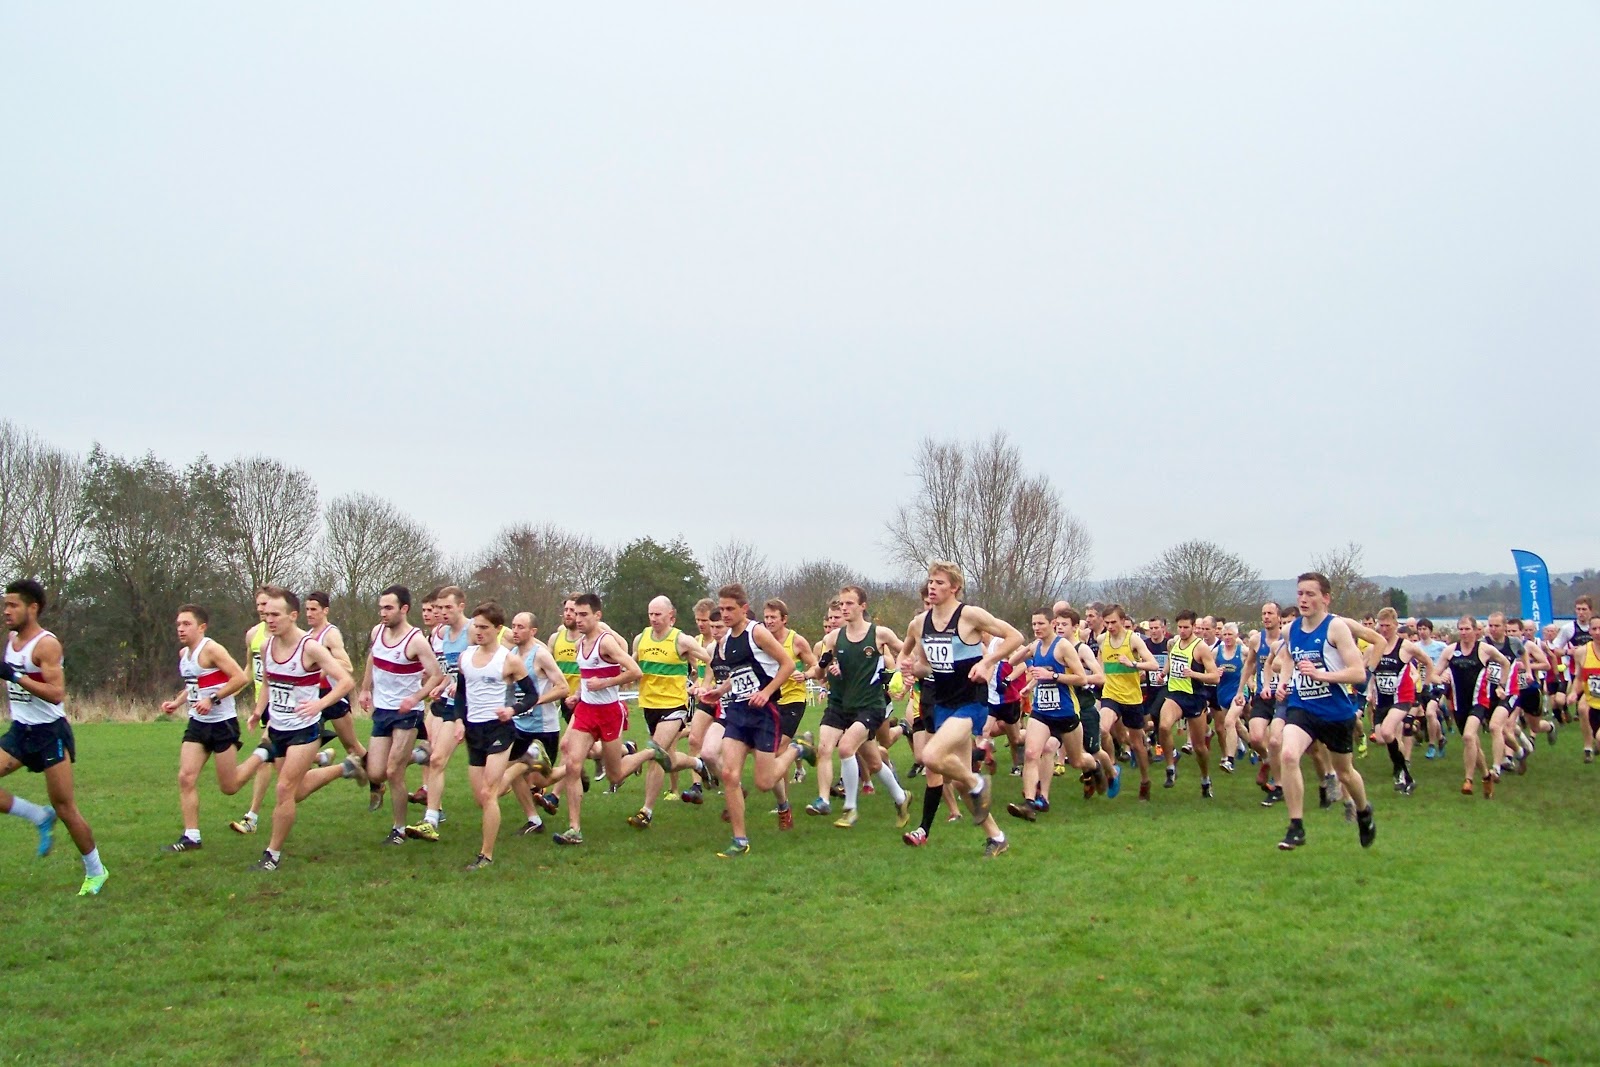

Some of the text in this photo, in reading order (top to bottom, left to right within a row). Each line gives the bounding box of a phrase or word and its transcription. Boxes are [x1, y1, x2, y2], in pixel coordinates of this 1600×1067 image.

[643, 647, 668, 656] CORNWALL
[928, 646, 948, 661] 219
[733, 675, 754, 692] 234
[1379, 678, 1394, 687] 276
[1040, 690, 1054, 701] 241
